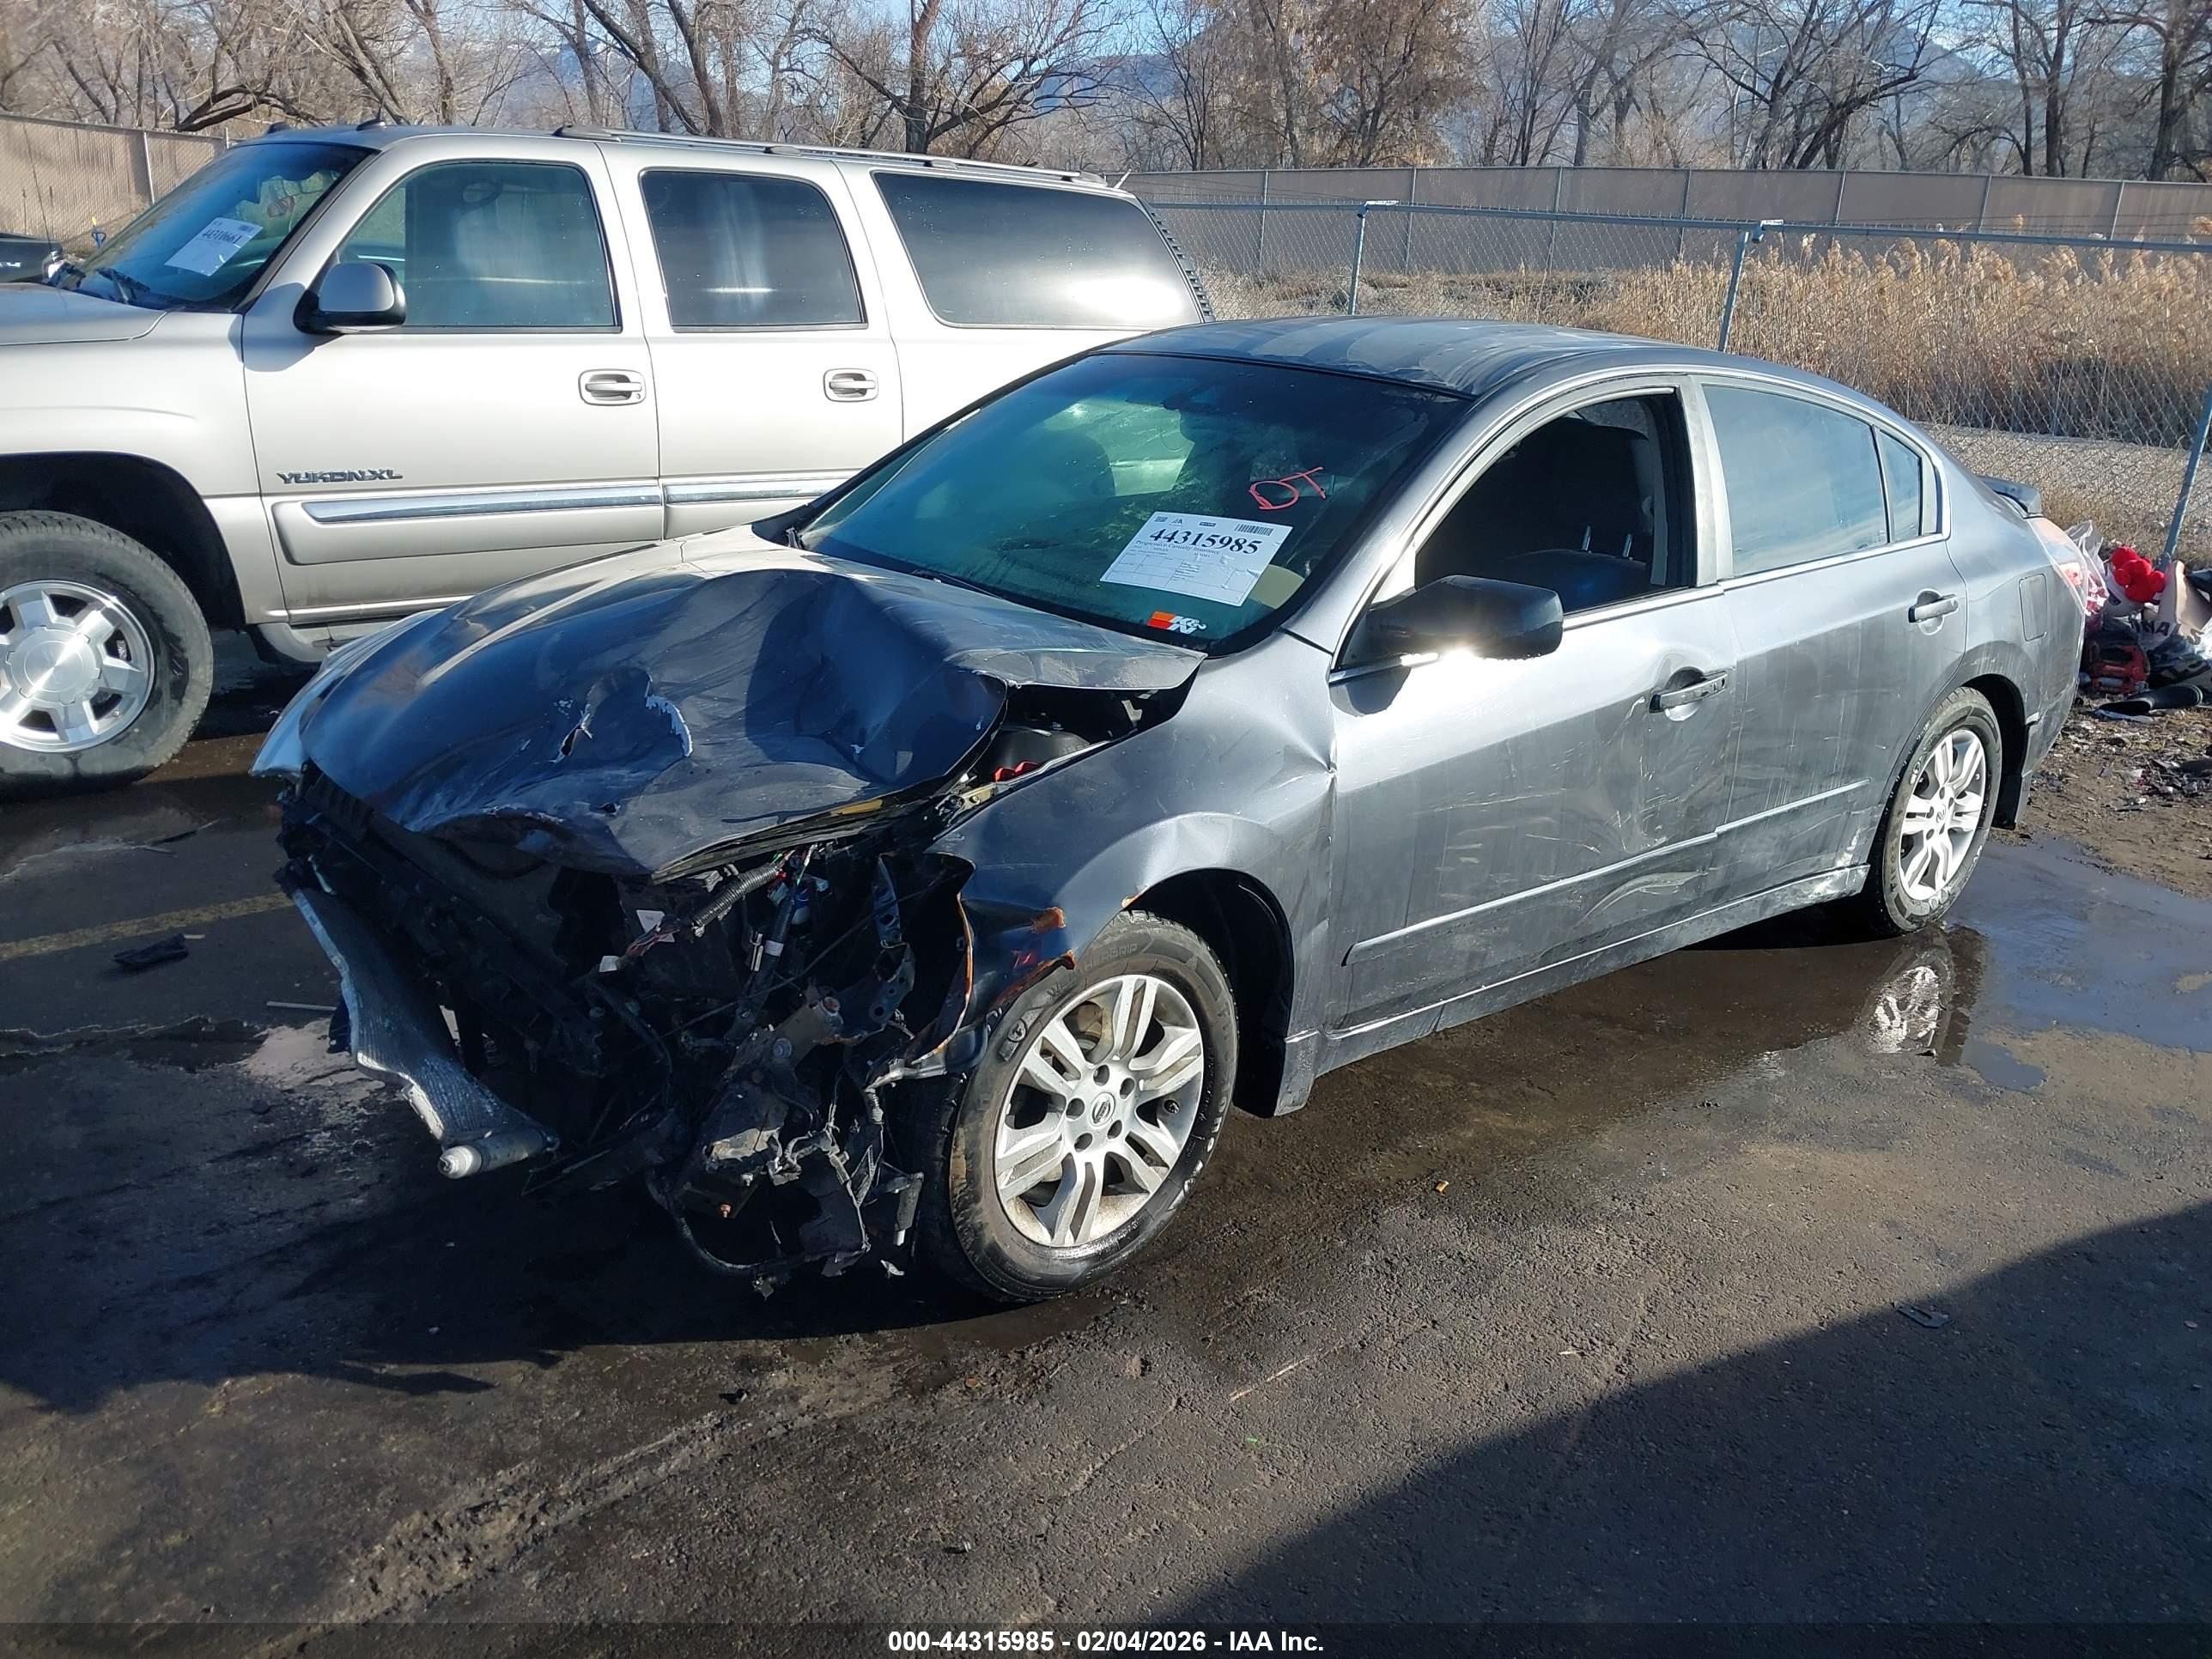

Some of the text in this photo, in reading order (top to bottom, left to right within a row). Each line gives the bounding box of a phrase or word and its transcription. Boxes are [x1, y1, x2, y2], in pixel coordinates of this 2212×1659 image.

[276, 469, 404, 483] YUKON XL
[1150, 528, 1263, 555] 44315985
[1193, 545, 1221, 556] Insurance
